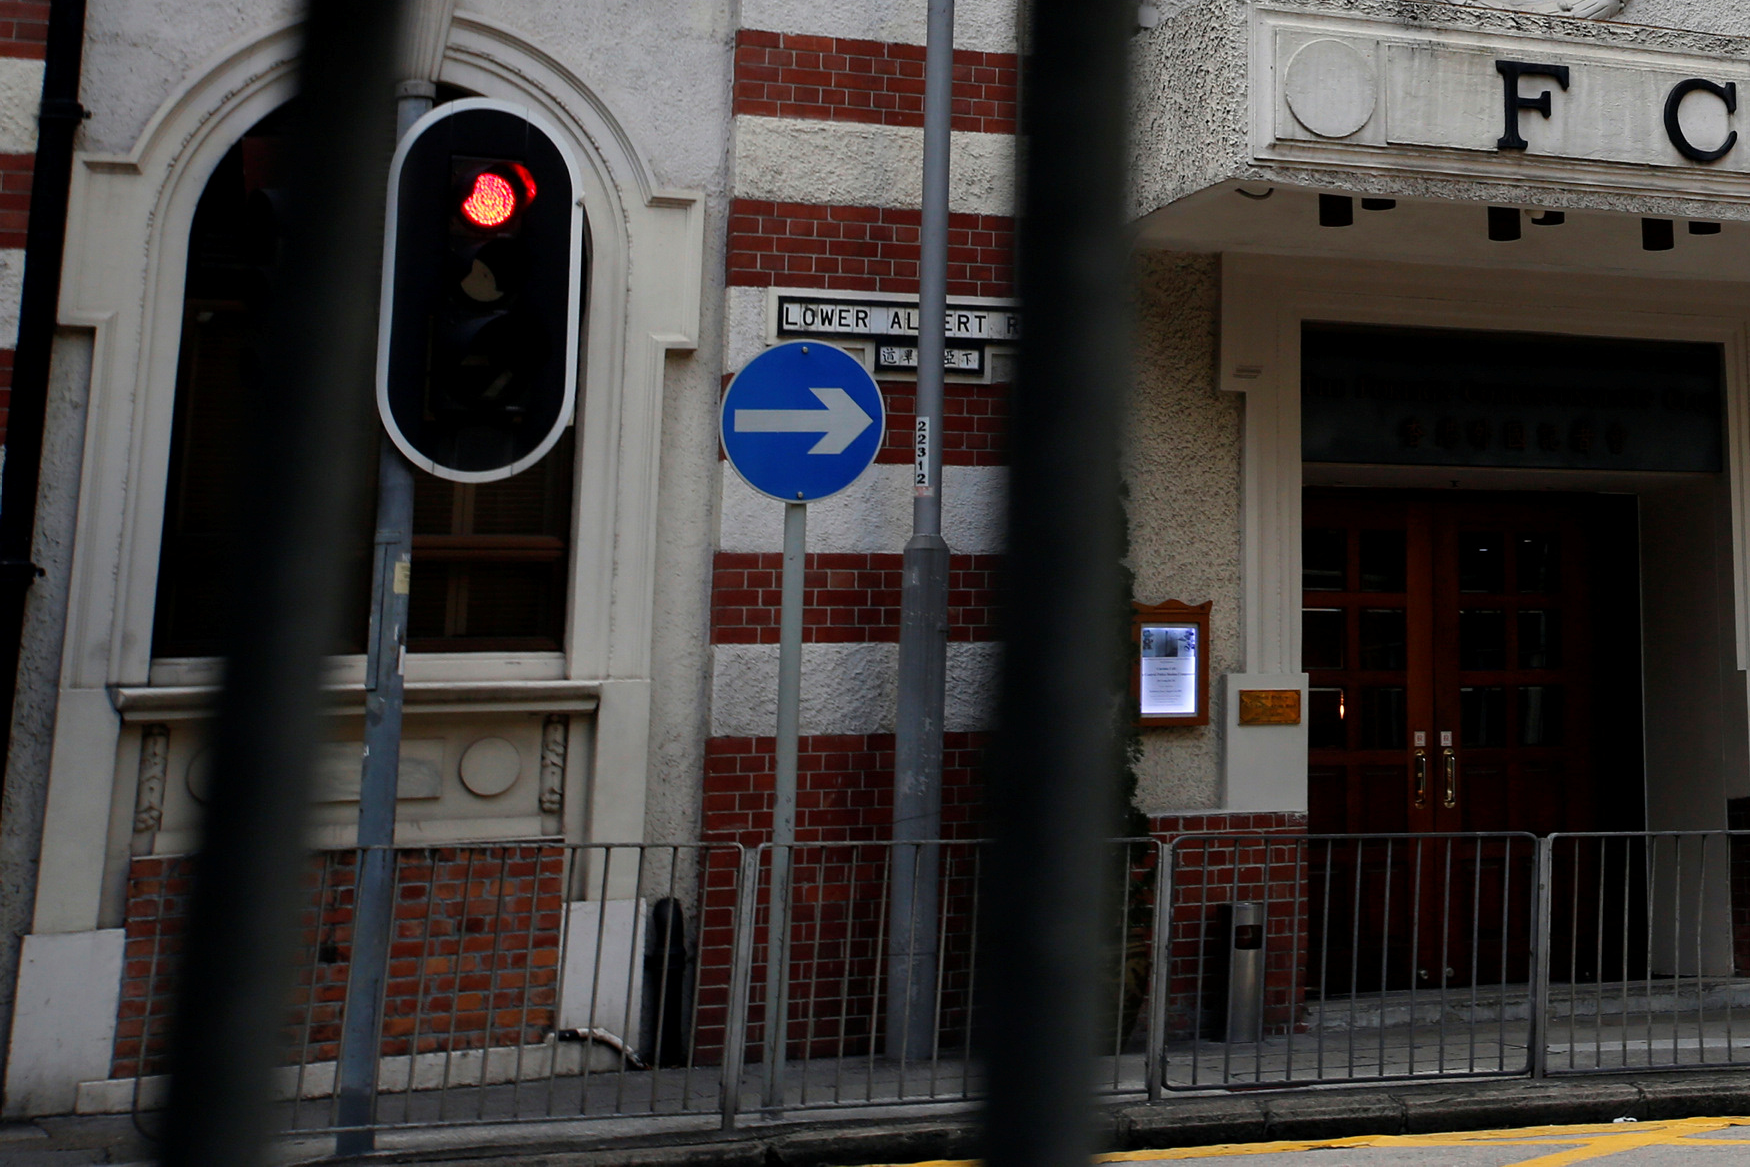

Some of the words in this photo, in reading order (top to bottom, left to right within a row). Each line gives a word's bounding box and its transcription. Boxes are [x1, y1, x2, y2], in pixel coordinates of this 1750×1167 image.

[785, 306, 869, 329] LOWER
[890, 311, 987, 334] ALERT
[916, 420, 927, 485] 22312
